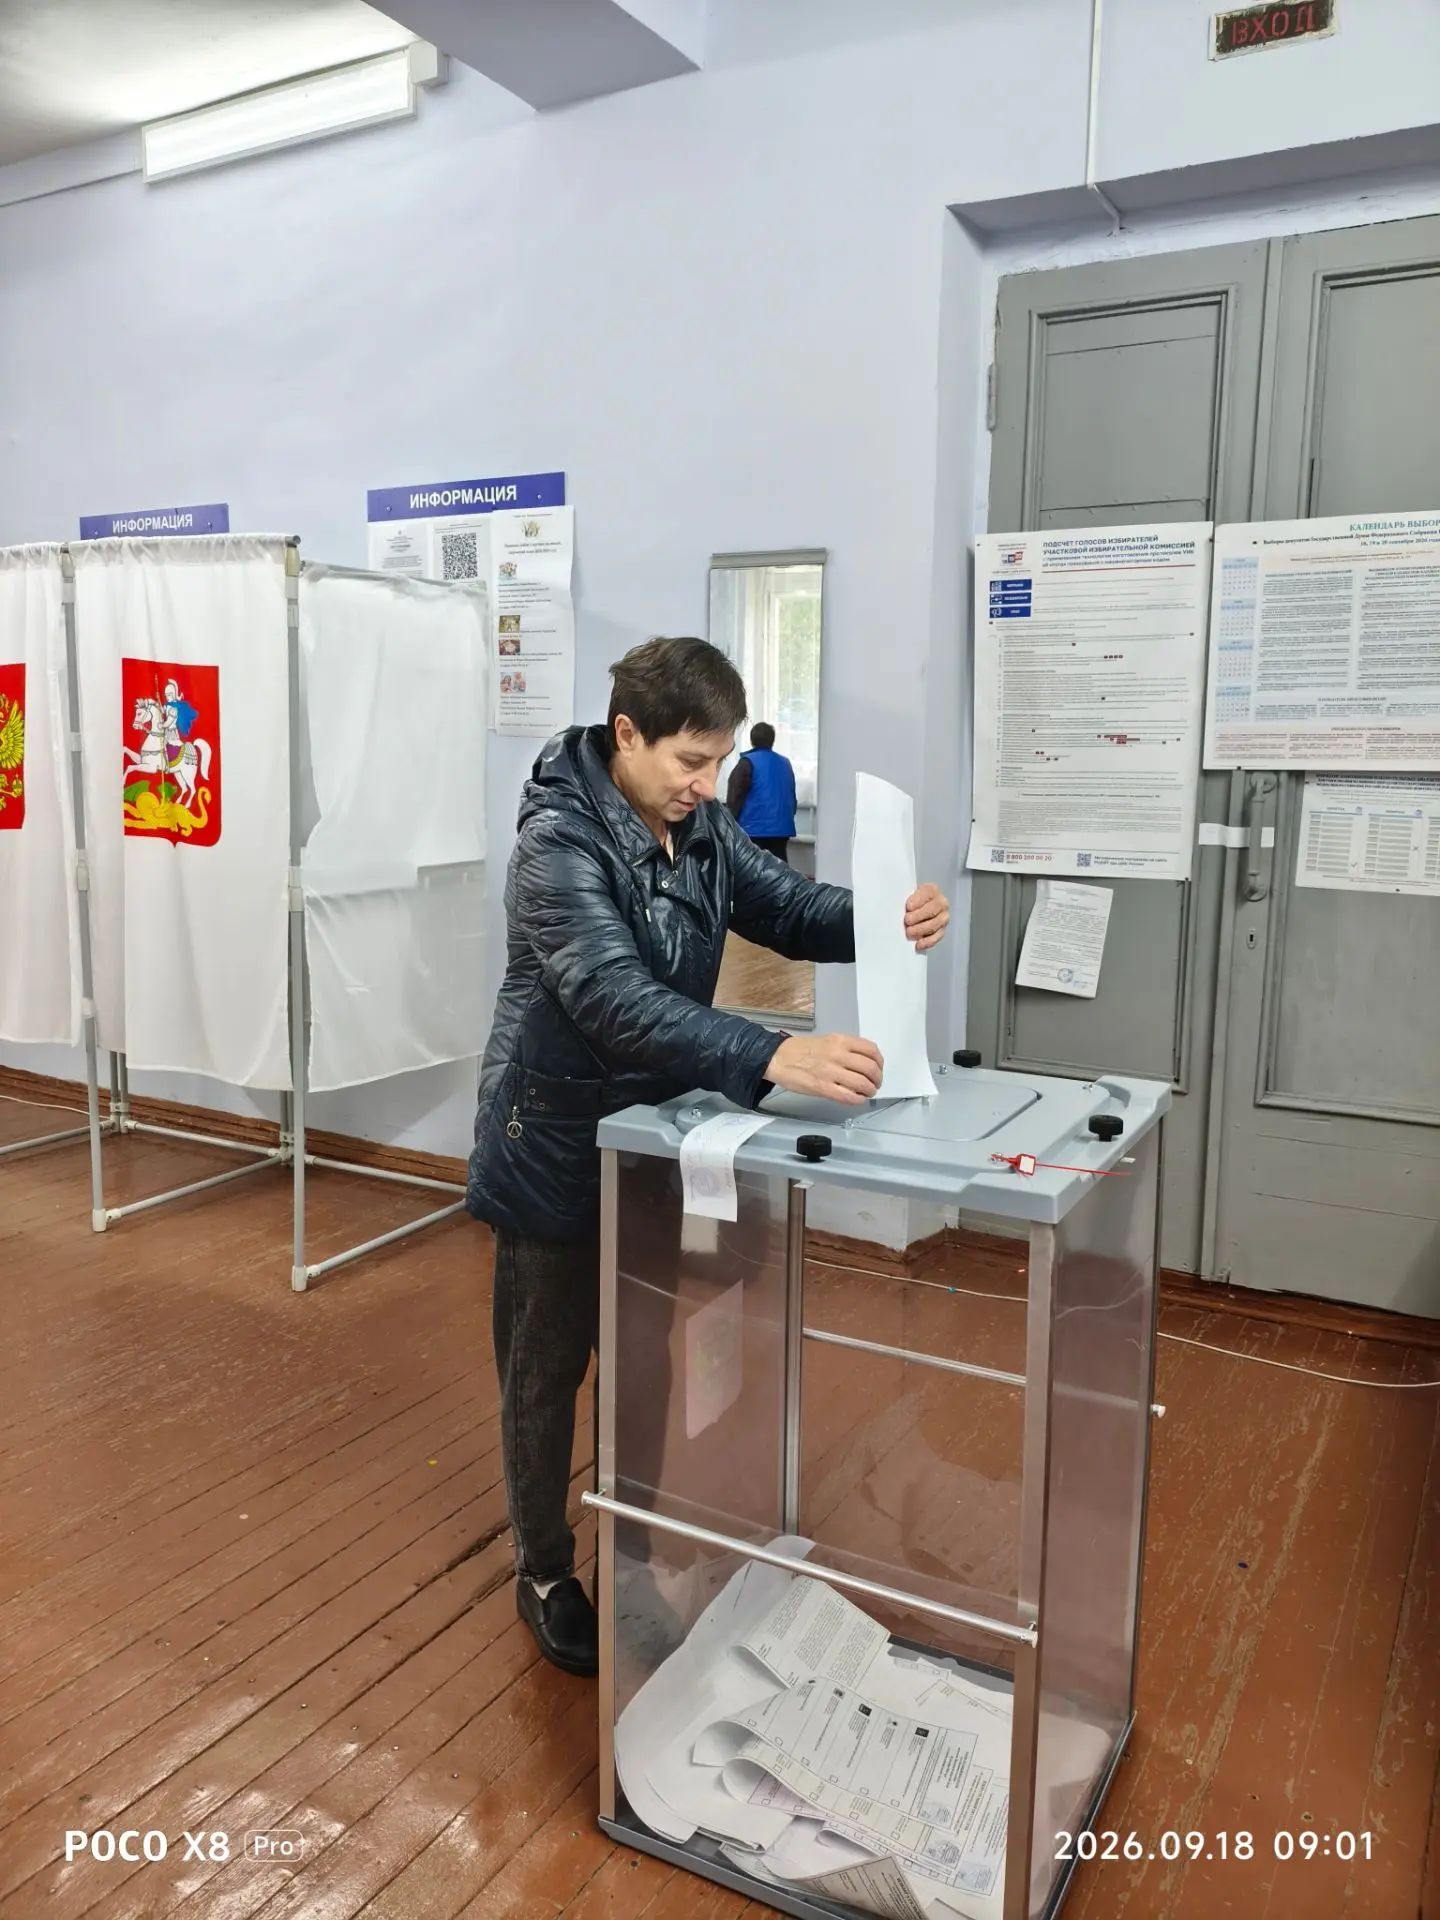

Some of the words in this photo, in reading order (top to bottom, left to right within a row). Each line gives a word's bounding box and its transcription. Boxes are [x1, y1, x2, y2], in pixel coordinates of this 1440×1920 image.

[410, 485, 517, 509] ИНФОРМАЦИЯ
[112, 513, 193, 533] ИНФОРМАЦИЯ
[1349, 521, 1405, 531] КАЛЕНДАРЬ
[1075, 538, 1107, 546] ГОЛОСОВ
[1108, 534, 1158, 544] ИЗБИРАТЕЛЕЙ
[1043, 546, 1088, 555] УЧАСТКОВОЙ
[1088, 543, 1149, 553] ИЗБИРАТЕЛЬНОЙ
[1150, 541, 1195, 550] КОМИССИЕЙ
